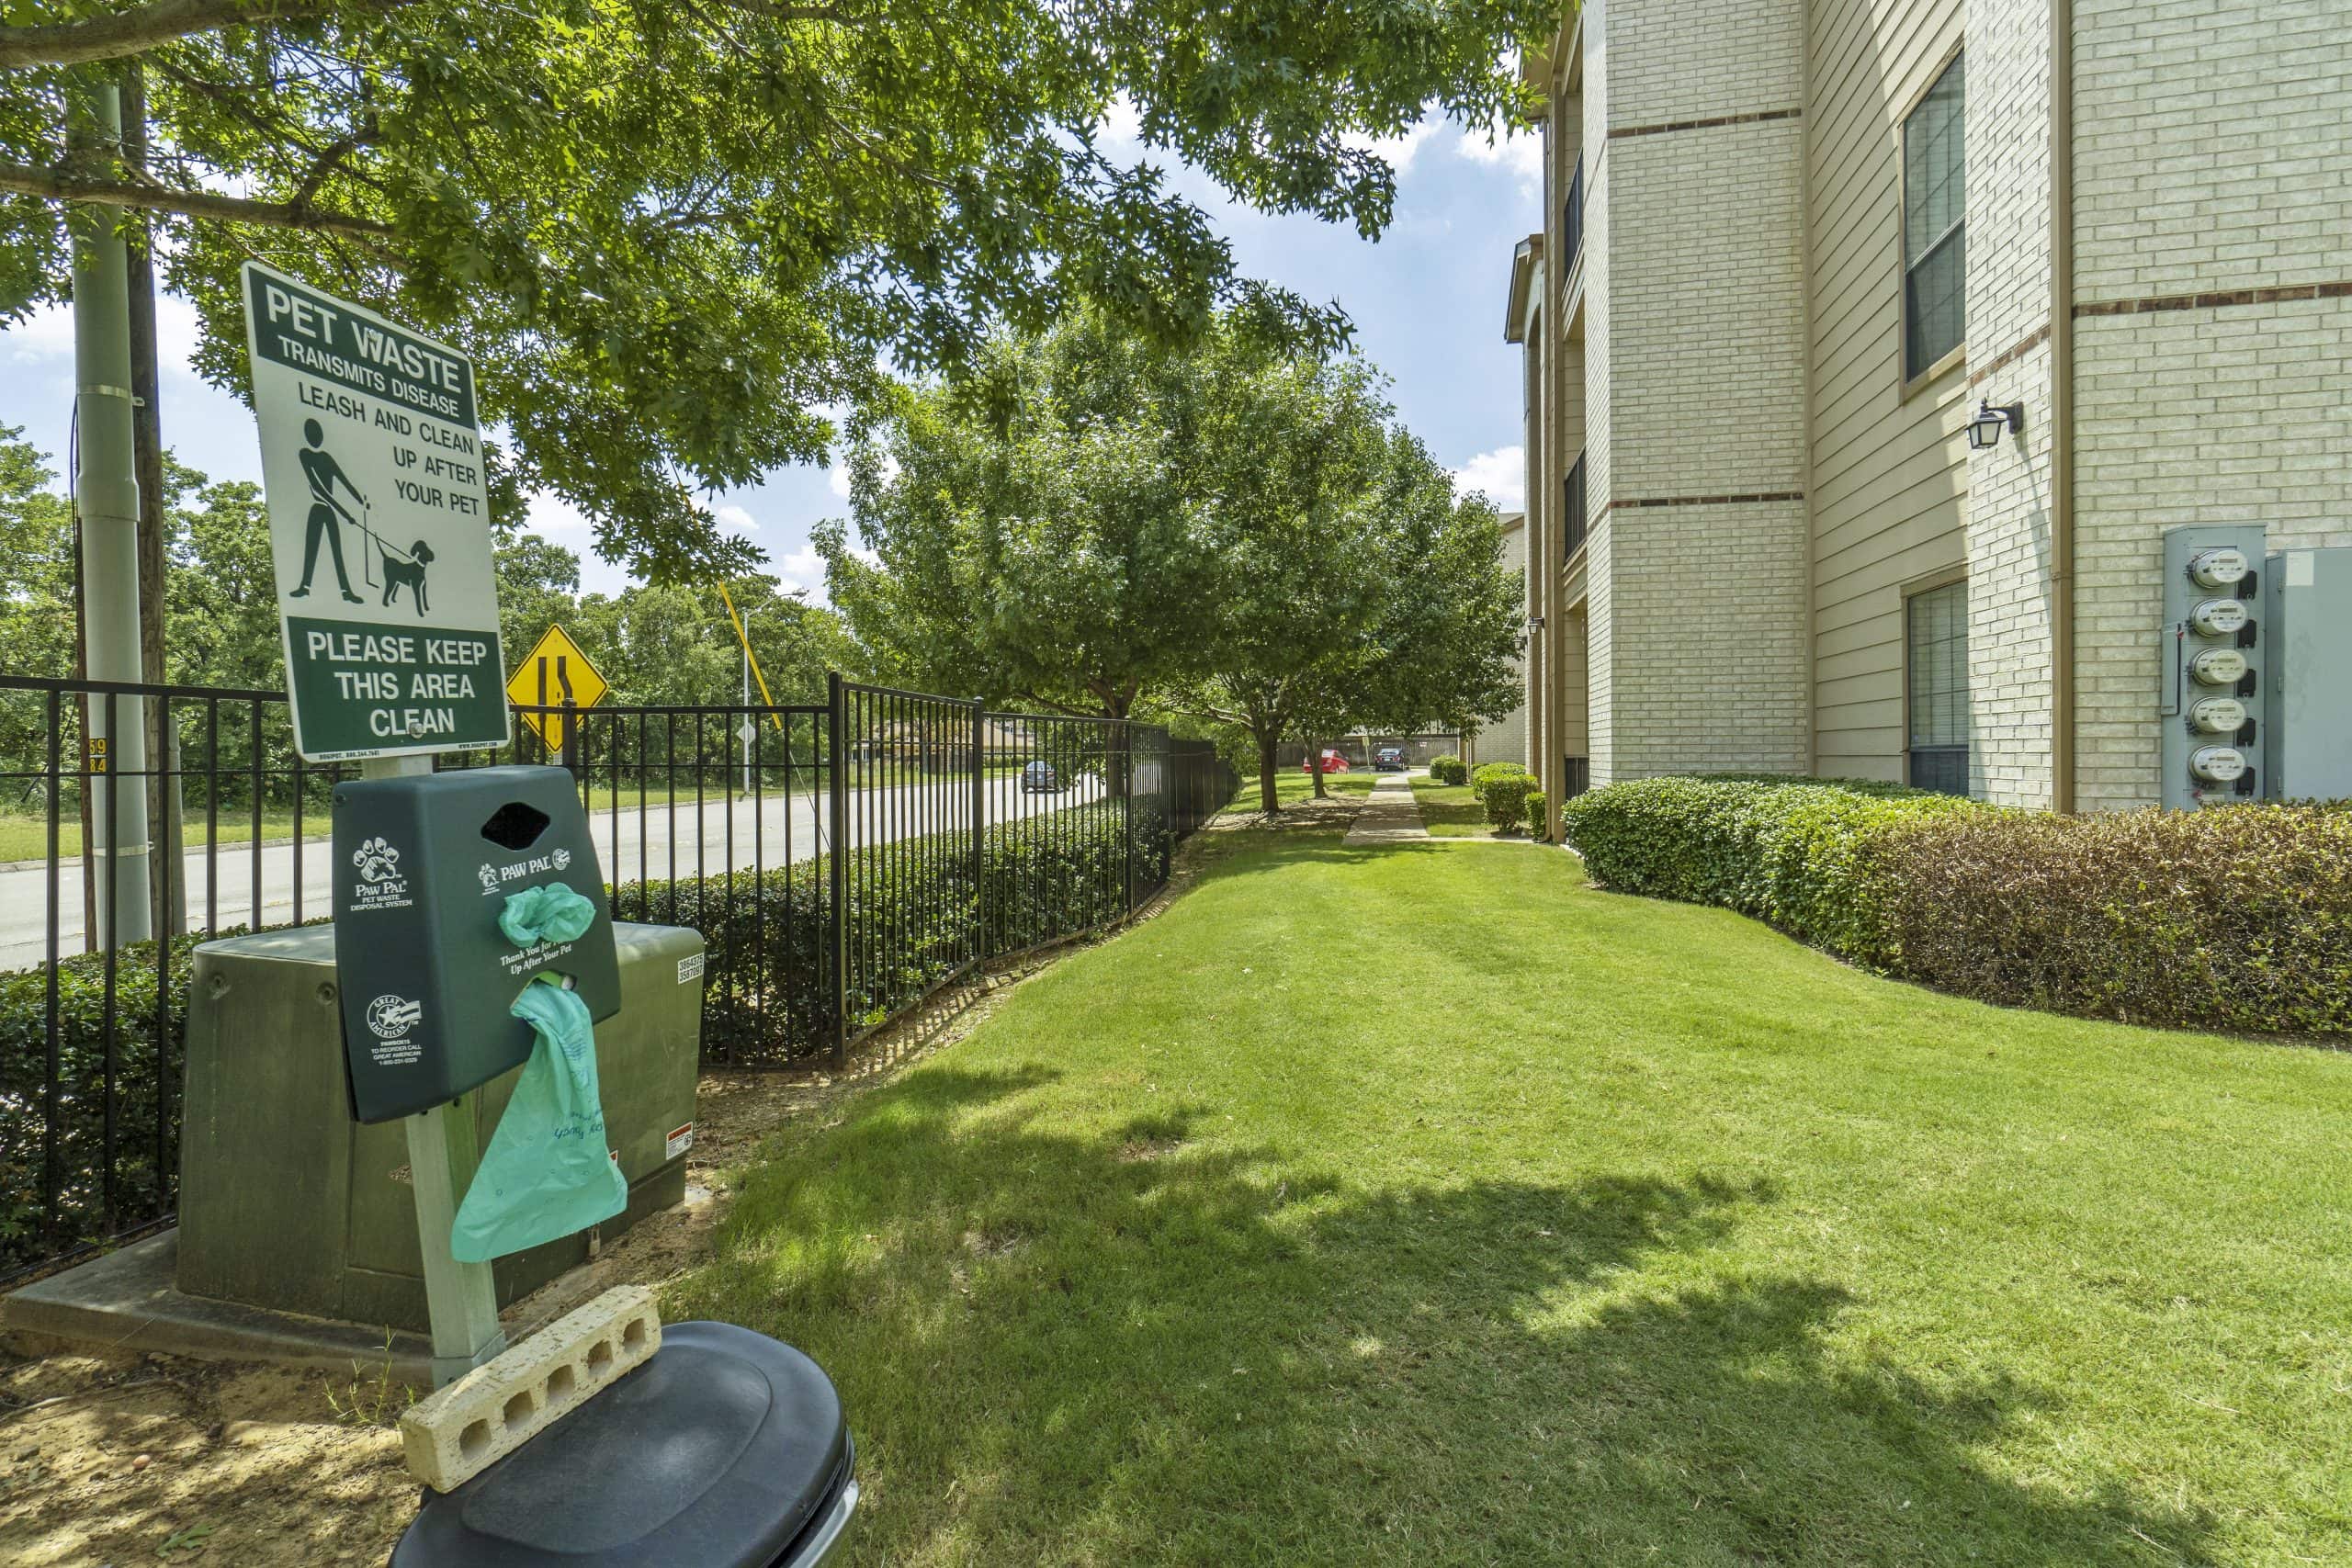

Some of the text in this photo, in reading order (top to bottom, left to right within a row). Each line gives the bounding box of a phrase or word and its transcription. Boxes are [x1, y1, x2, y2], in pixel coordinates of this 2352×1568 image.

[266, 284, 462, 393] PET WASTE
[277, 334, 460, 419] TRANSMITS DISEASE
[298, 381, 474, 456] LEASH AND CLEAN
[393, 446, 477, 486] UP AFTER
[394, 479, 479, 516] YOUR PET
[307, 631, 487, 665] PLEASE KEEP
[334, 672, 475, 700] THIS AREA
[370, 708, 455, 737] CLEAN
[500, 862, 526, 881] PAW
[528, 856, 552, 874] PAL
[350, 899, 413, 911] DISPOSAL SYSTEM
[355, 885, 380, 897] PAW
[377, 894, 401, 902] WASTE
[500, 950, 525, 966] Thank
[526, 945, 540, 956] You
[541, 941, 551, 953] for
[511, 944, 571, 975] Up After Your Pet
[374, 997, 400, 1008] GREAT
[369, 1021, 406, 1037] AMERICAN
